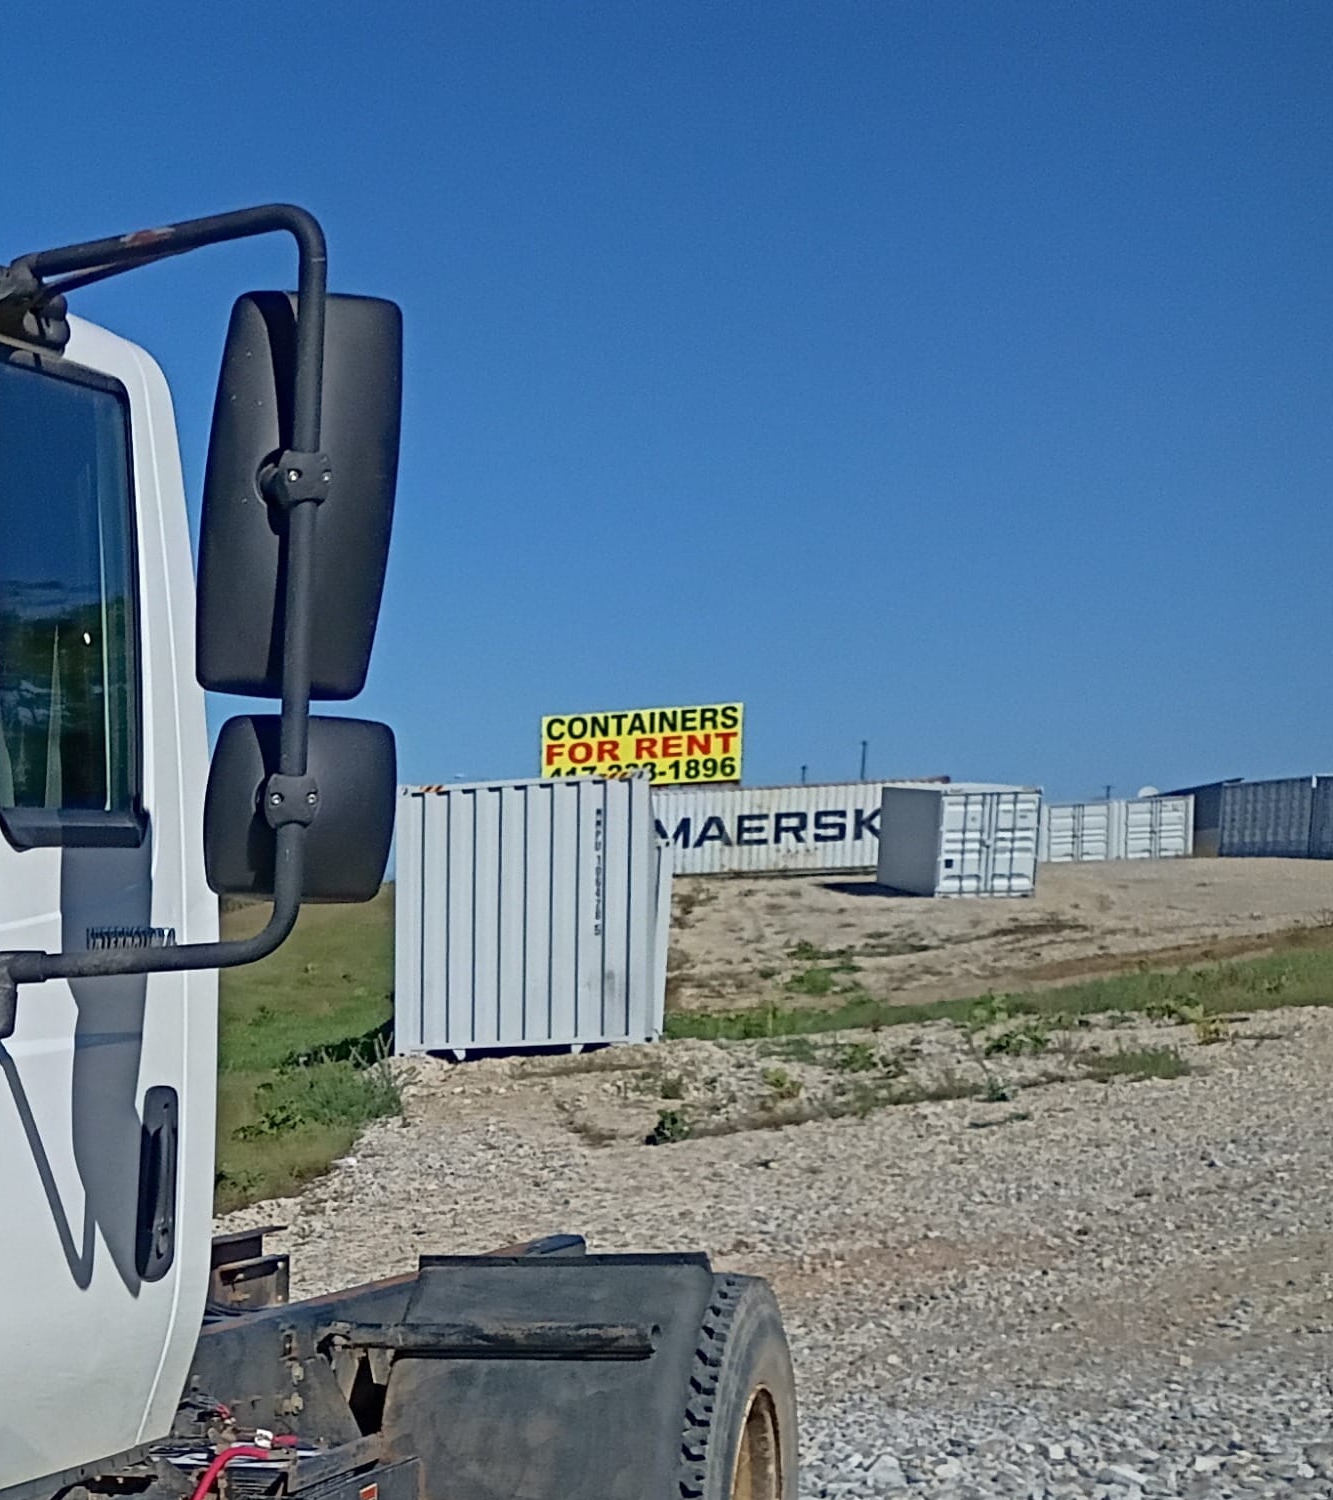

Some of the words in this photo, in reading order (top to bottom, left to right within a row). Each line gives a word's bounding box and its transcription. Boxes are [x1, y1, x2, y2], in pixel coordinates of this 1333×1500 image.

[546, 706, 738, 741] CONTAINERS
[546, 742, 621, 766] FOR
[635, 732, 737, 760] RENT
[654, 808, 882, 850] MAERSK
